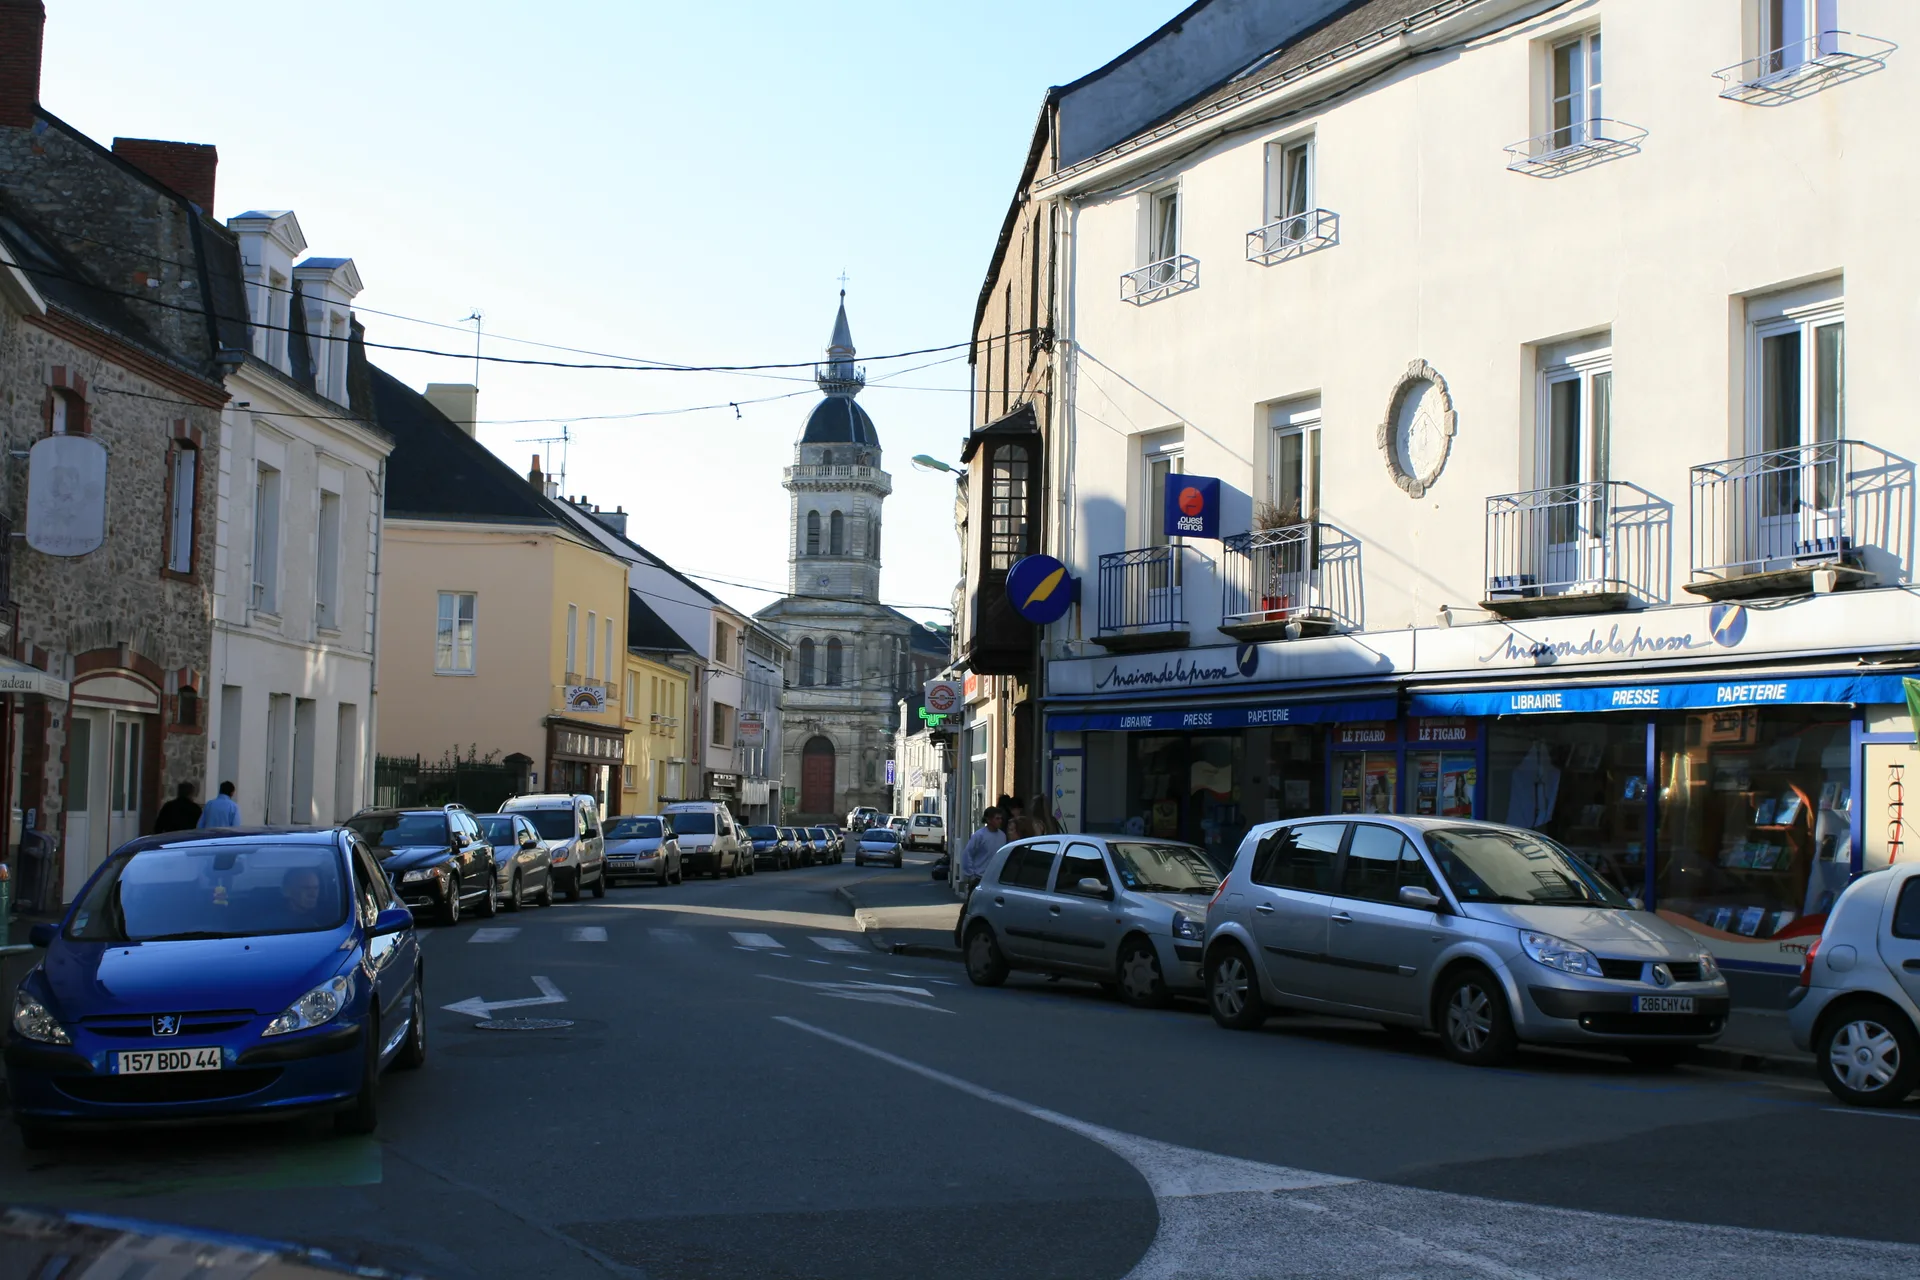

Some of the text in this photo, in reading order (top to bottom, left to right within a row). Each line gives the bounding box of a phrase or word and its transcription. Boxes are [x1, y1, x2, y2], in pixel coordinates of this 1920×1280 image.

[1177, 520, 1203, 531] france
[1180, 516, 1203, 525] ouest
[593, 690, 604, 705] CIEL
[1511, 684, 1788, 710] LIBRAIRIE PRESSE PAPETERIE
[1120, 708, 1289, 728] LIBRAIRIE PRESSE PAPETERIE
[1342, 729, 1386, 742] LE FIGARO
[1419, 727, 1466, 741] LE FIGARO
[1887, 764, 1904, 855] ROUGE
[1641, 997, 1691, 1012] 286 CHY 44
[123, 1053, 154, 1073] 157
[157, 1051, 192, 1071] BDD
[196, 1050, 218, 1068] 44
